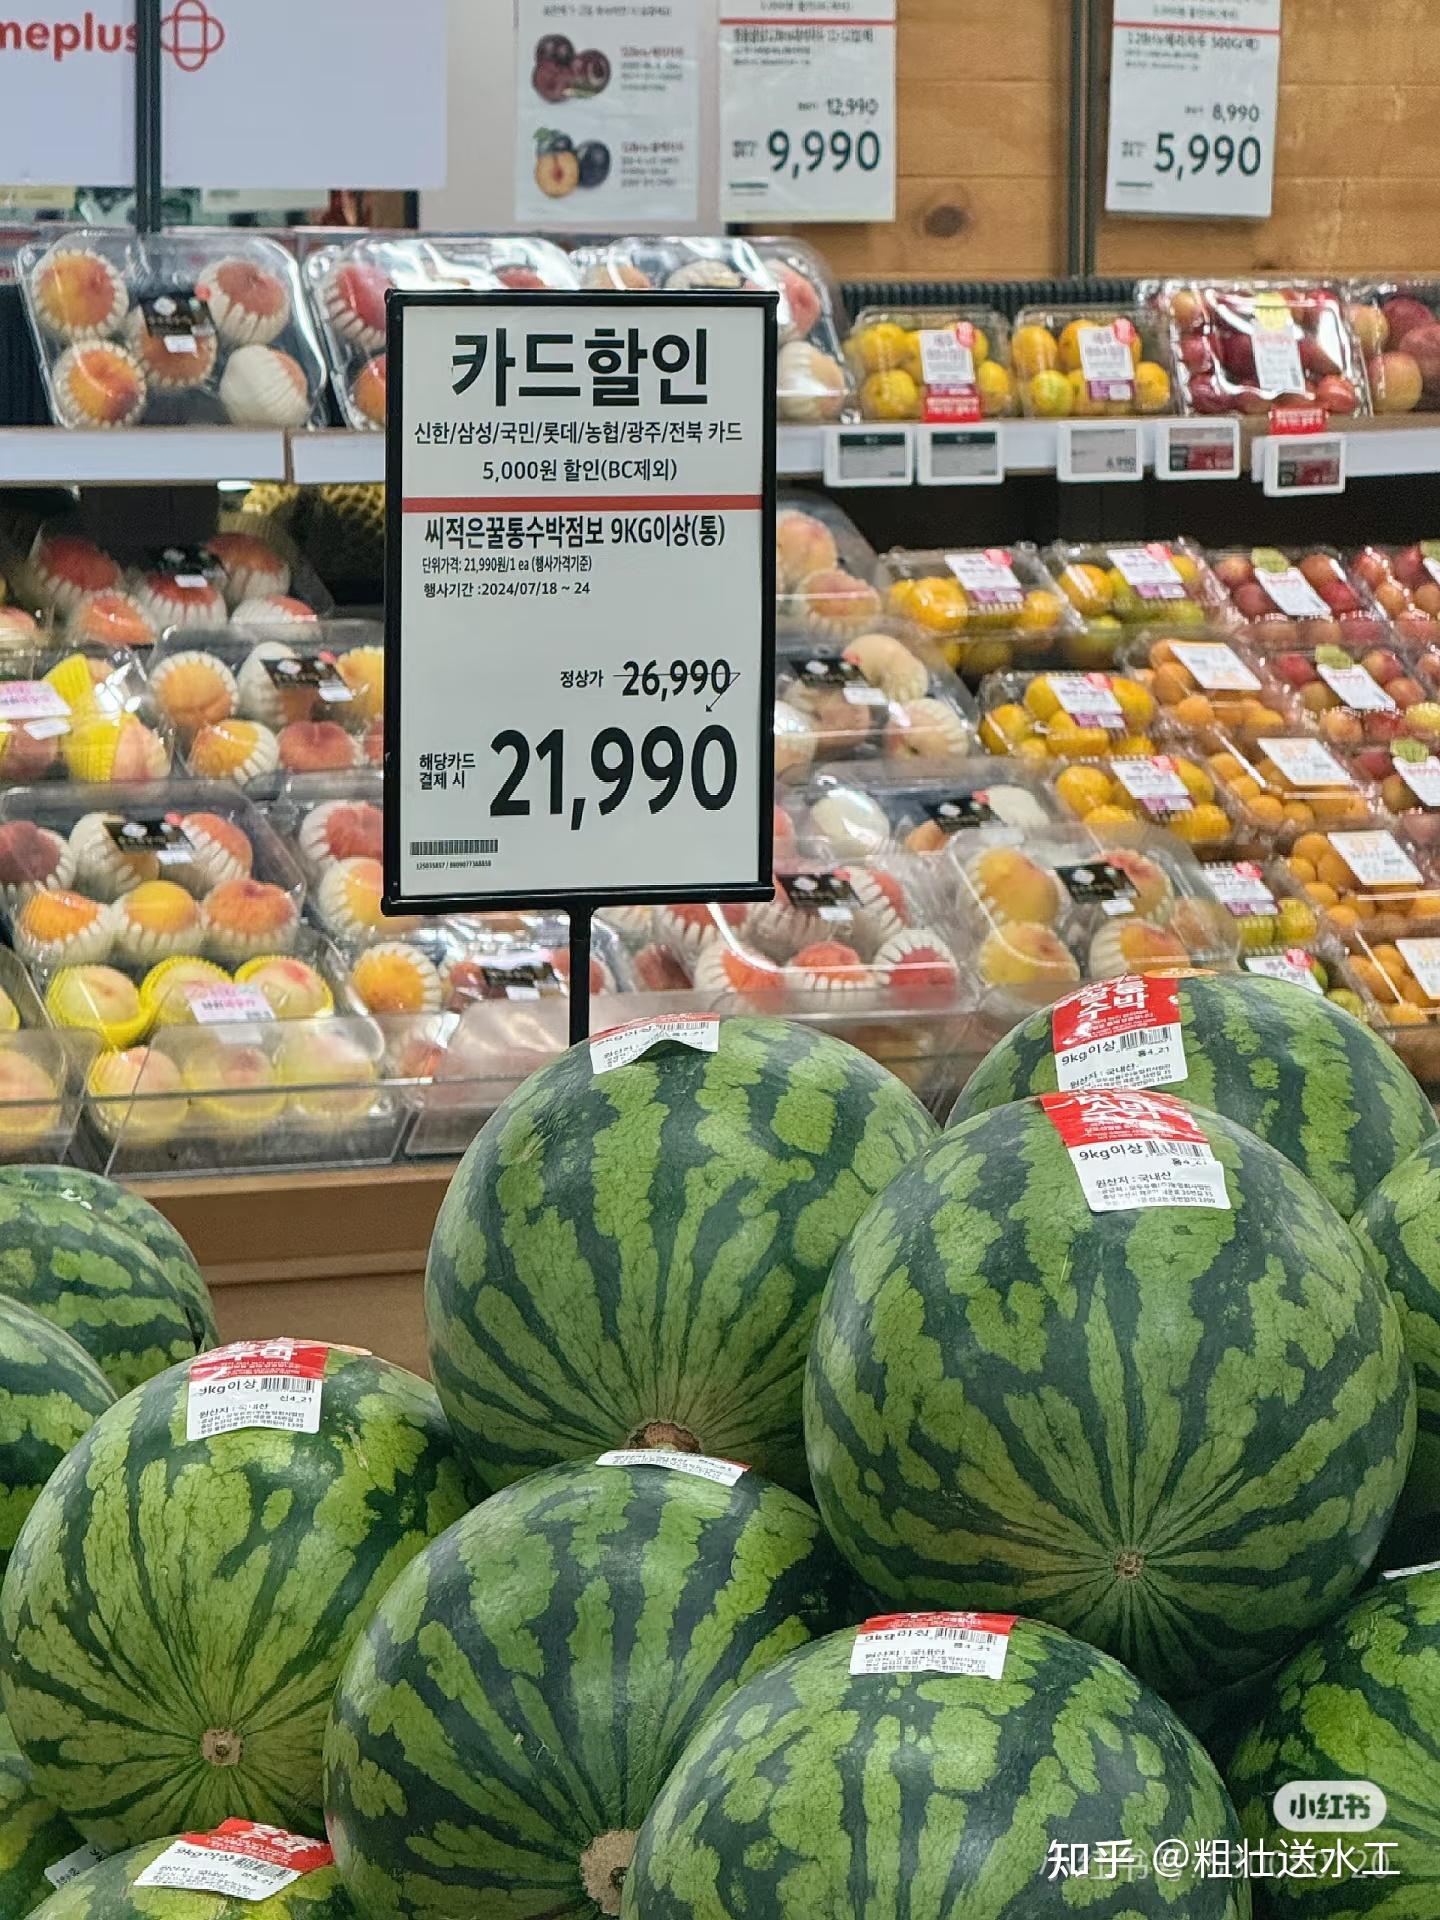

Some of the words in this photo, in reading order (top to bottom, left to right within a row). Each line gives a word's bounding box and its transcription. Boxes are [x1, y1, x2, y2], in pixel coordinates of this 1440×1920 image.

[826, 97, 879, 118] 12,990
[1212, 104, 1260, 123] 8,990
[768, 129, 881, 180] 9,990
[1153, 132, 1262, 182] 5,990
[451, 327, 708, 407] 카드할인
[414, 420, 703, 445] 신한/삼성/국민/롯데/농협/광주/전북
[708, 420, 743, 443] 카드
[482, 459, 557, 483] 5,000원
[563, 458, 678, 483] 할인(BC제외)
[424, 515, 604, 551] 씨적은꿀통수박점보
[610, 513, 725, 548] 9KG이상(통)
[422, 556, 462, 575] 단위가격:
[464, 555, 516, 574] 21,990원/1
[518, 560, 529, 571] ea
[531, 554, 593, 573] (행사가격기준)
[423, 581, 474, 599] 행사기간
[477, 581, 557, 597] :2024/07/18
[574, 581, 591, 595] 24
[560, 669, 604, 689] 정상가
[621, 658, 732, 702] 26,990
[419, 751, 476, 770] 해당카드
[419, 771, 448, 791] 결제
[452, 771, 465, 790] 시
[489, 724, 738, 831] 21,990
[1061, 1041, 1116, 1066] 9kg이상
[1106, 1062, 1136, 1076] 국내산
[1078, 1143, 1143, 1161] 9kg이상
[1096, 1176, 1129, 1189] 원산지
[1138, 1171, 1172, 1184] 국내산
